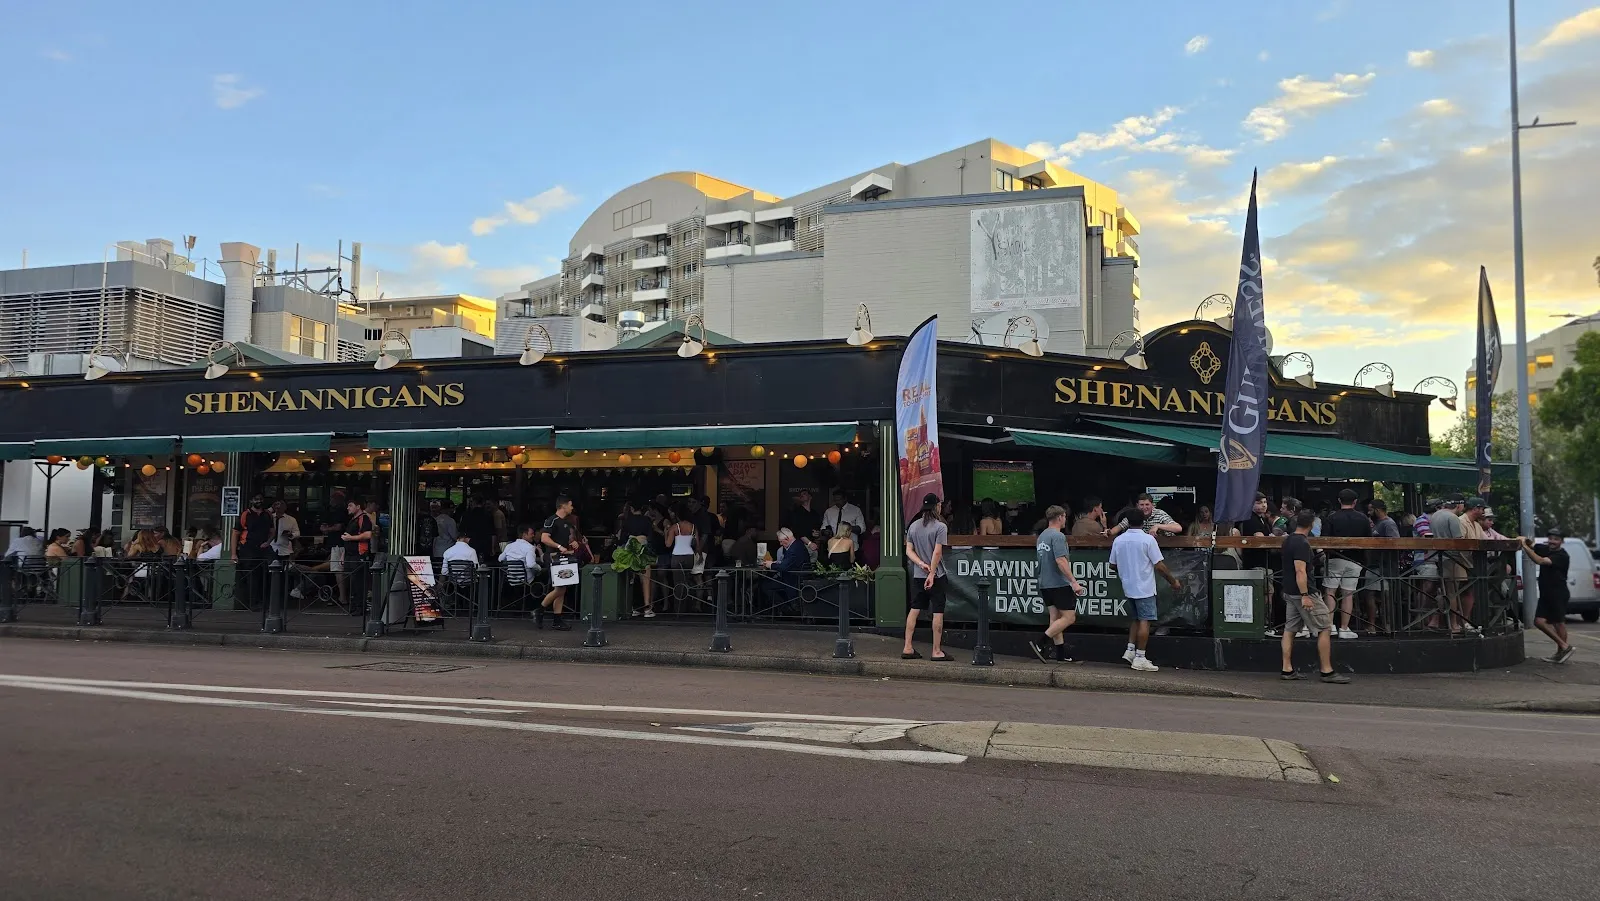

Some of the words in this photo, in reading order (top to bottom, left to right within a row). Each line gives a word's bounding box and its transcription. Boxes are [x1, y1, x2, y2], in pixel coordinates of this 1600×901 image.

[184, 382, 465, 415] SHENANNIGANS
[191, 485, 203, 493] THE
[957, 560, 1039, 577] DARWIN'
[996, 579, 1039, 596] LIVE
[1075, 580, 1108, 597] SIC
[995, 597, 1045, 614] DAYS
[1075, 599, 1128, 616] WEEK
